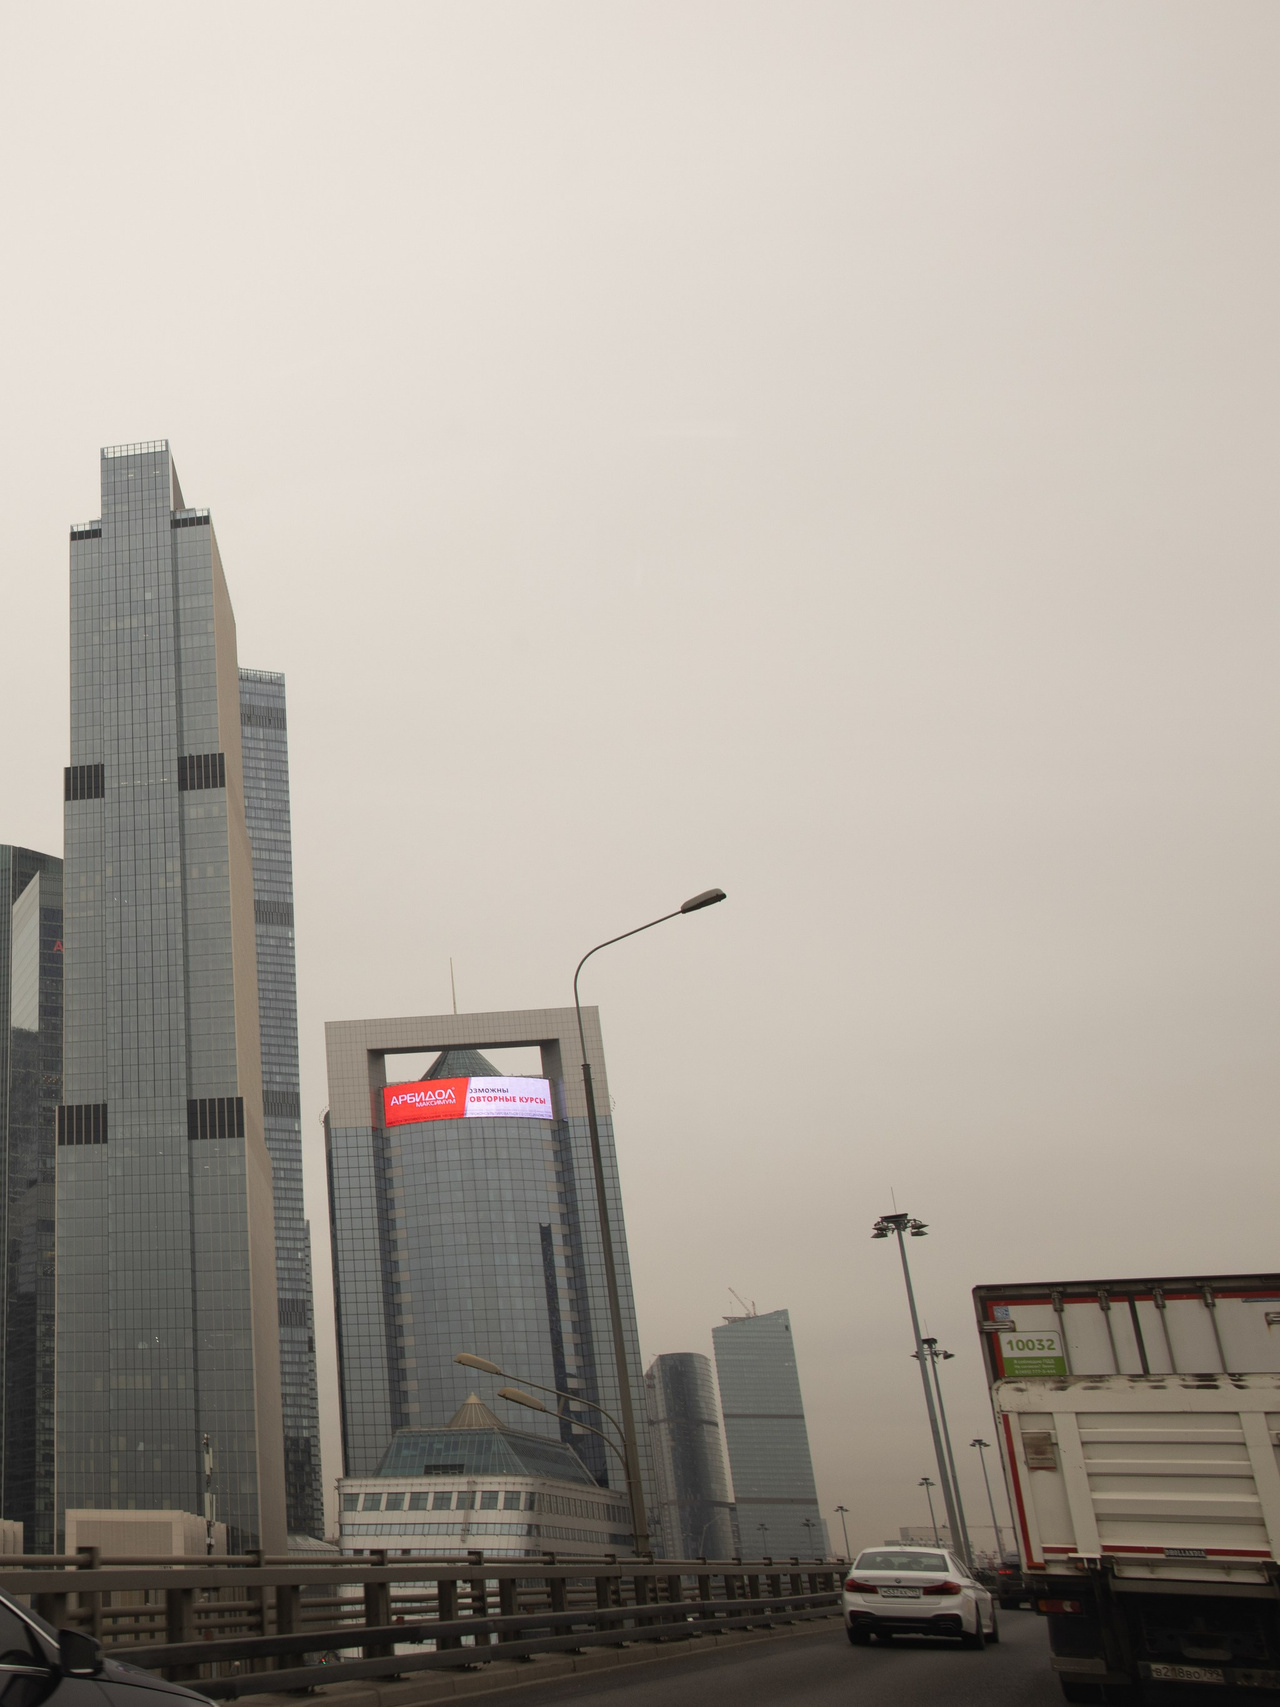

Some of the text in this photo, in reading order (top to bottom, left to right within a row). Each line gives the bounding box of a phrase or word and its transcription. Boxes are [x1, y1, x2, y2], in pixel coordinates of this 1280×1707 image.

[390, 1089, 455, 1106] АРБИДОЛ
[469, 1095, 546, 1104] ОВТОРНЫЕ КУРСЫ
[415, 1099, 456, 1108] МАКСИМУМ
[1006, 1338, 1056, 1351] 10032
